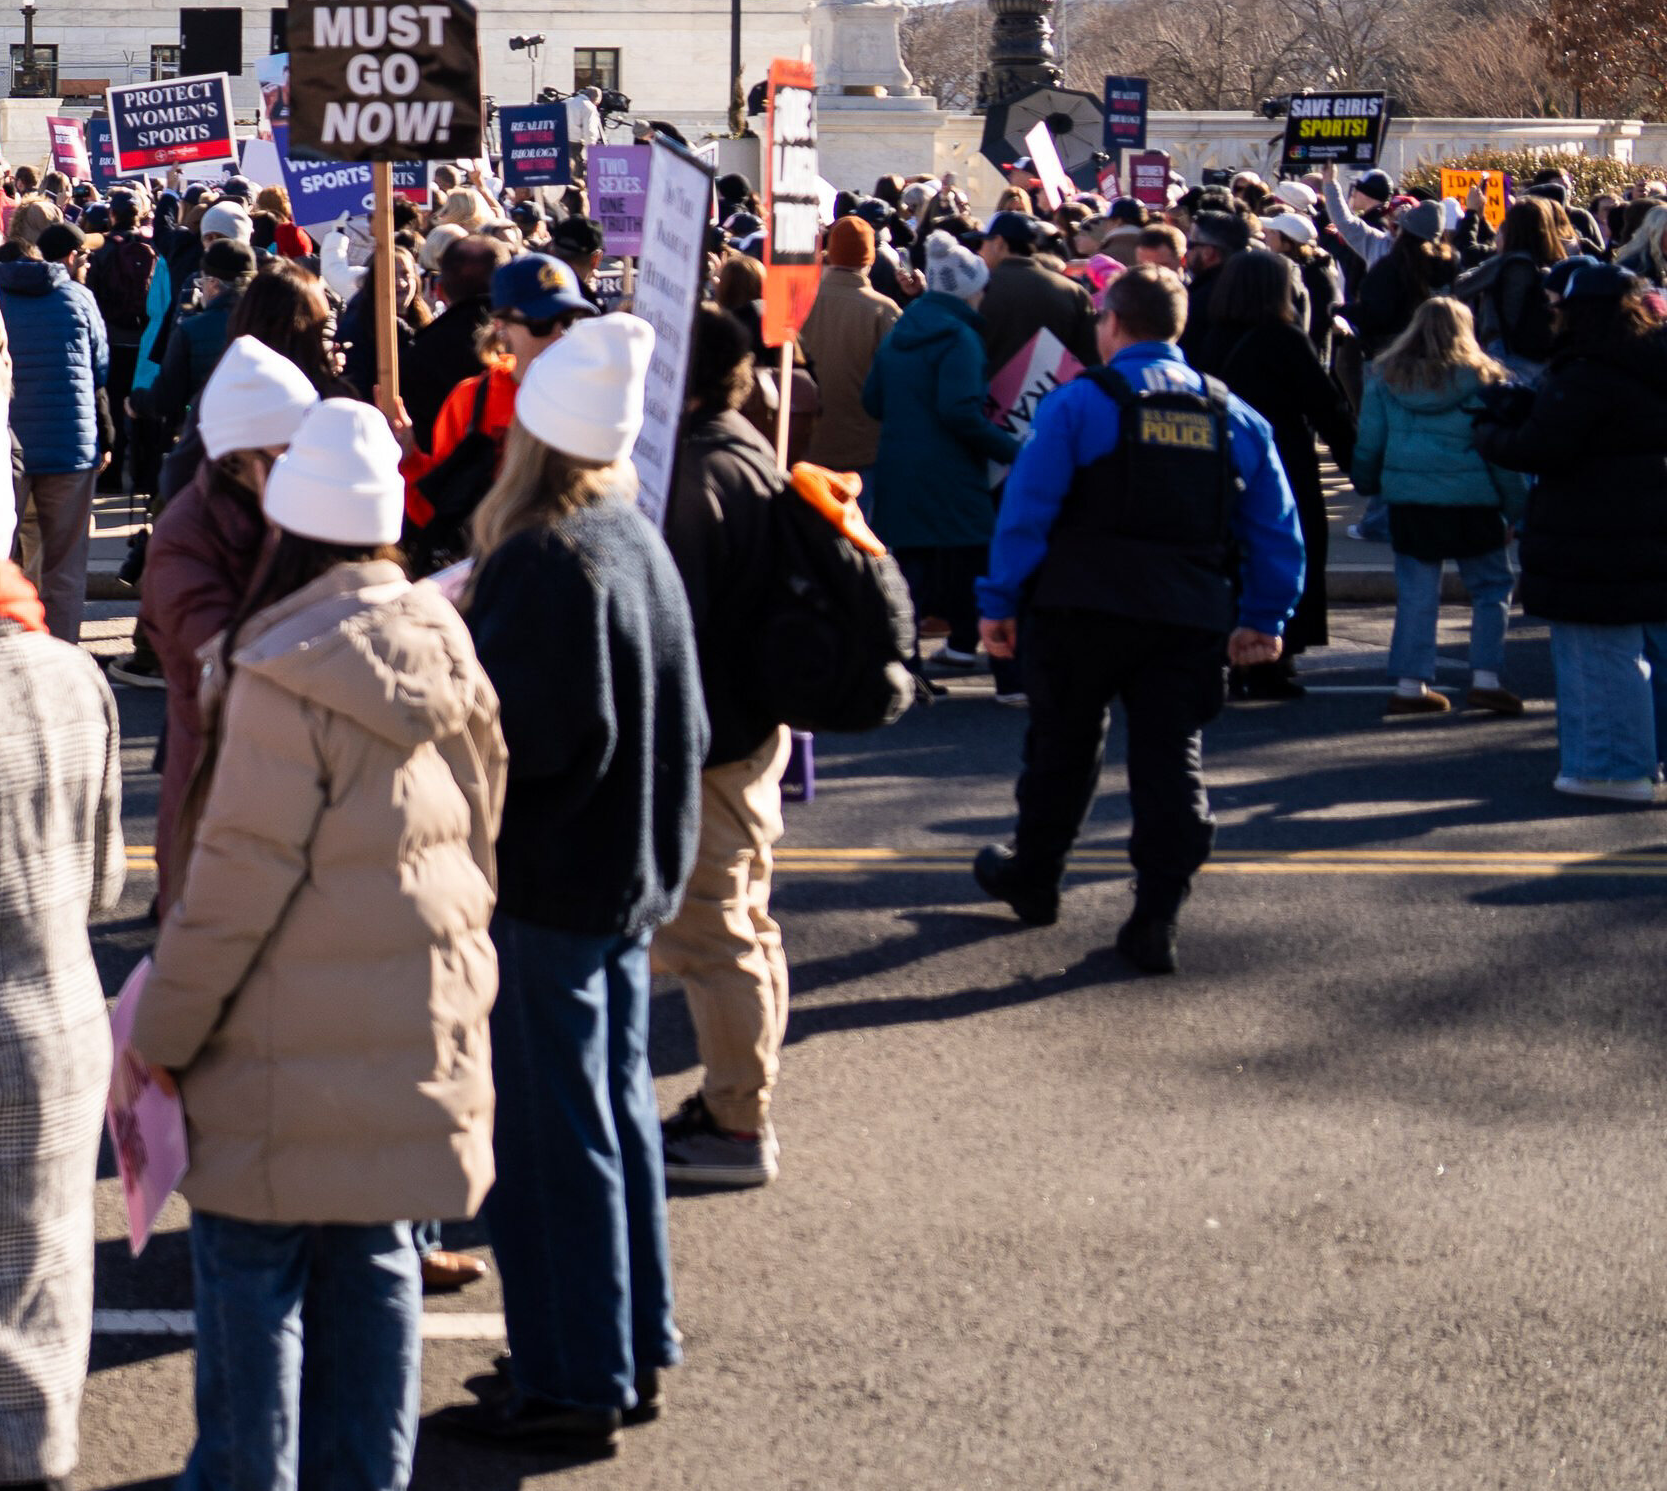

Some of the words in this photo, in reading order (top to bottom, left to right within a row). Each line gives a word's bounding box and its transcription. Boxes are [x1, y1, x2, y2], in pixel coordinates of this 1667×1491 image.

[313, 4, 453, 48] MUST
[345, 53, 419, 97] GO
[123, 81, 215, 109] PROTECT
[123, 101, 220, 129] WOMEN'S
[1290, 98, 1332, 118] SAVE
[320, 99, 454, 145] NOW!
[510, 119, 558, 132] REALITY
[1299, 118, 1369, 138] SPORTS!
[137, 123, 212, 148] SPORTS
[510, 146, 561, 159] BIOLOGY
[300, 164, 372, 194] SPORTS
[597, 158, 629, 176] TWO
[597, 176, 646, 194] SEXES.
[599, 197, 625, 214] ONE
[1142, 420, 1212, 448] POLICE
